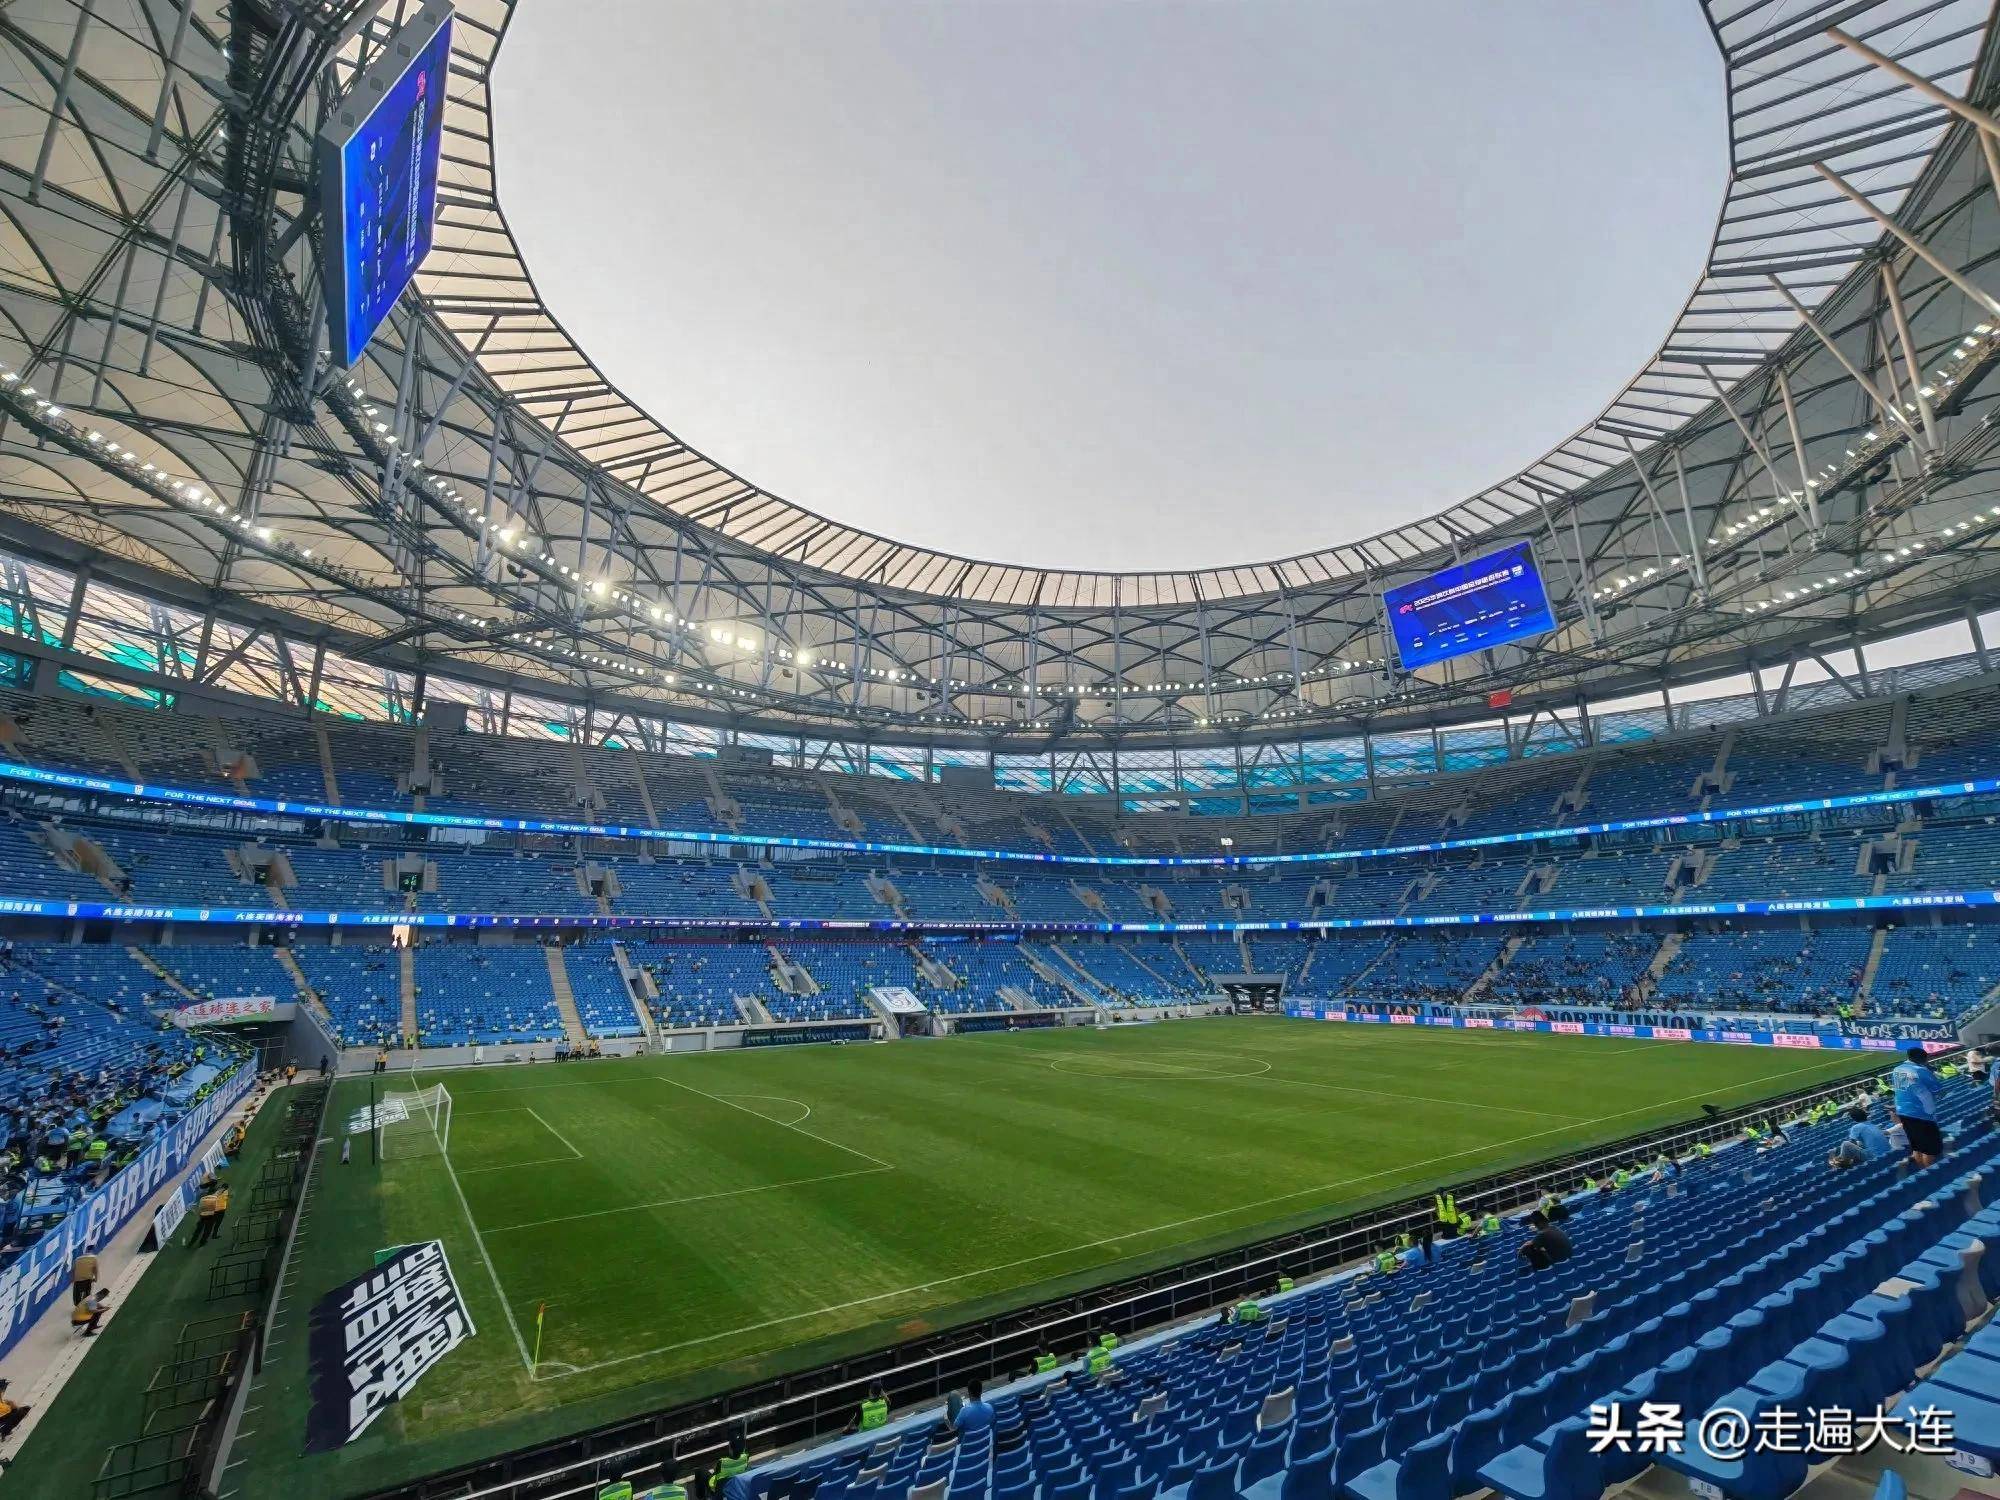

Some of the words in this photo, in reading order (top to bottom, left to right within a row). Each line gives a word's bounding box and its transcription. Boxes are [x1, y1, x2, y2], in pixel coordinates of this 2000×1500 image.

[10, 768, 30, 778] FOR
[34, 772, 54, 781] THE
[56, 776, 83, 785] NEXT
[165, 792, 183, 801] FOR
[187, 793, 204, 802] THE
[206, 796, 230, 805] NEXT
[233, 799, 256, 808] GOAL
[1851, 796, 1867, 805] FOR
[1871, 793, 1887, 802] THE
[304, 806, 322, 815] FOR
[325, 807, 340, 816] THE
[343, 809, 364, 818] NEXT
[366, 811, 387, 820] GOAL
[1727, 809, 1741, 818] FOR
[1744, 807, 1758, 816] THE
[1760, 806, 1781, 815] NEXT
[1545, 1010, 1619, 1024] NORTH
[1626, 1014, 1704, 1030] UNION
[341, 1242, 468, 1444] 通利晟信
